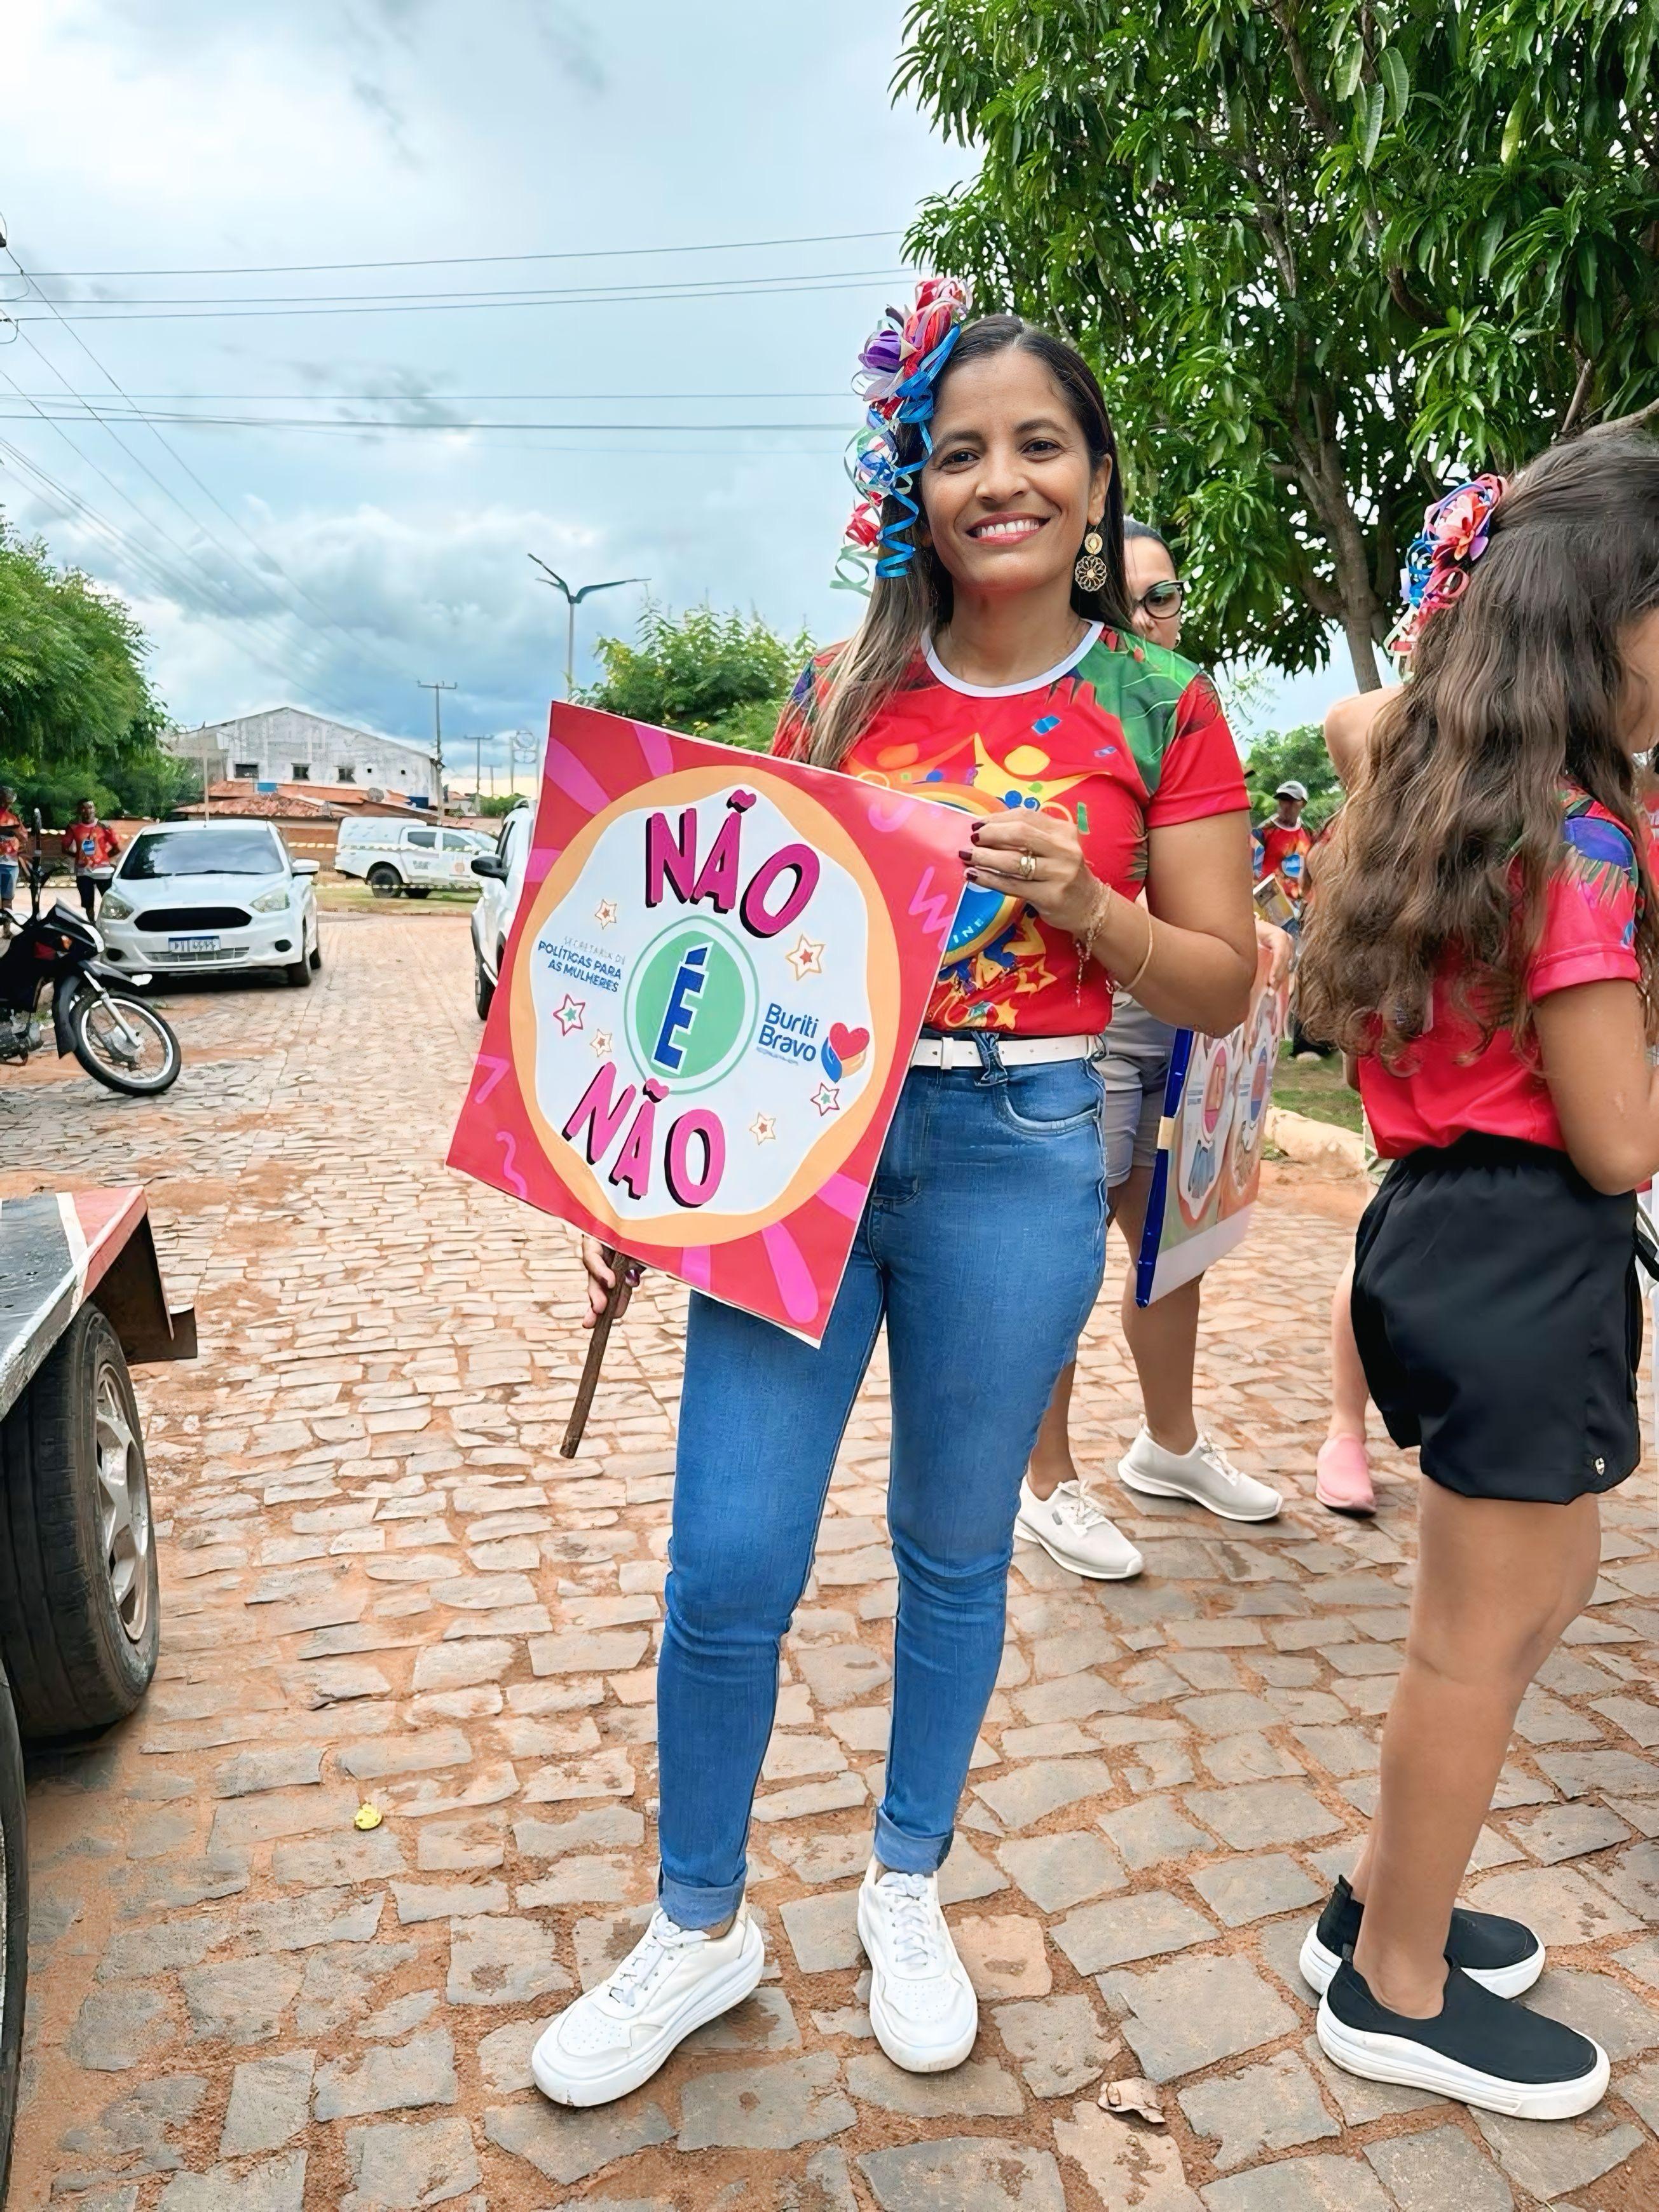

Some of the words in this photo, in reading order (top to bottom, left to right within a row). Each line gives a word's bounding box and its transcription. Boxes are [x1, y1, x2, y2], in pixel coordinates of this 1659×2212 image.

[645, 789, 820, 939] NÃO
[952, 918, 984, 944] INE
[538, 940, 593, 968] POLÍTICAS
[593, 960, 622, 980] PARA
[548, 959, 563, 972] AS
[563, 964, 619, 993] MULHERES
[651, 942, 713, 1074] É
[764, 1002, 819, 1039] Buriti
[758, 1024, 817, 1062] Bravo
[561, 1061, 726, 1208] NÃO
